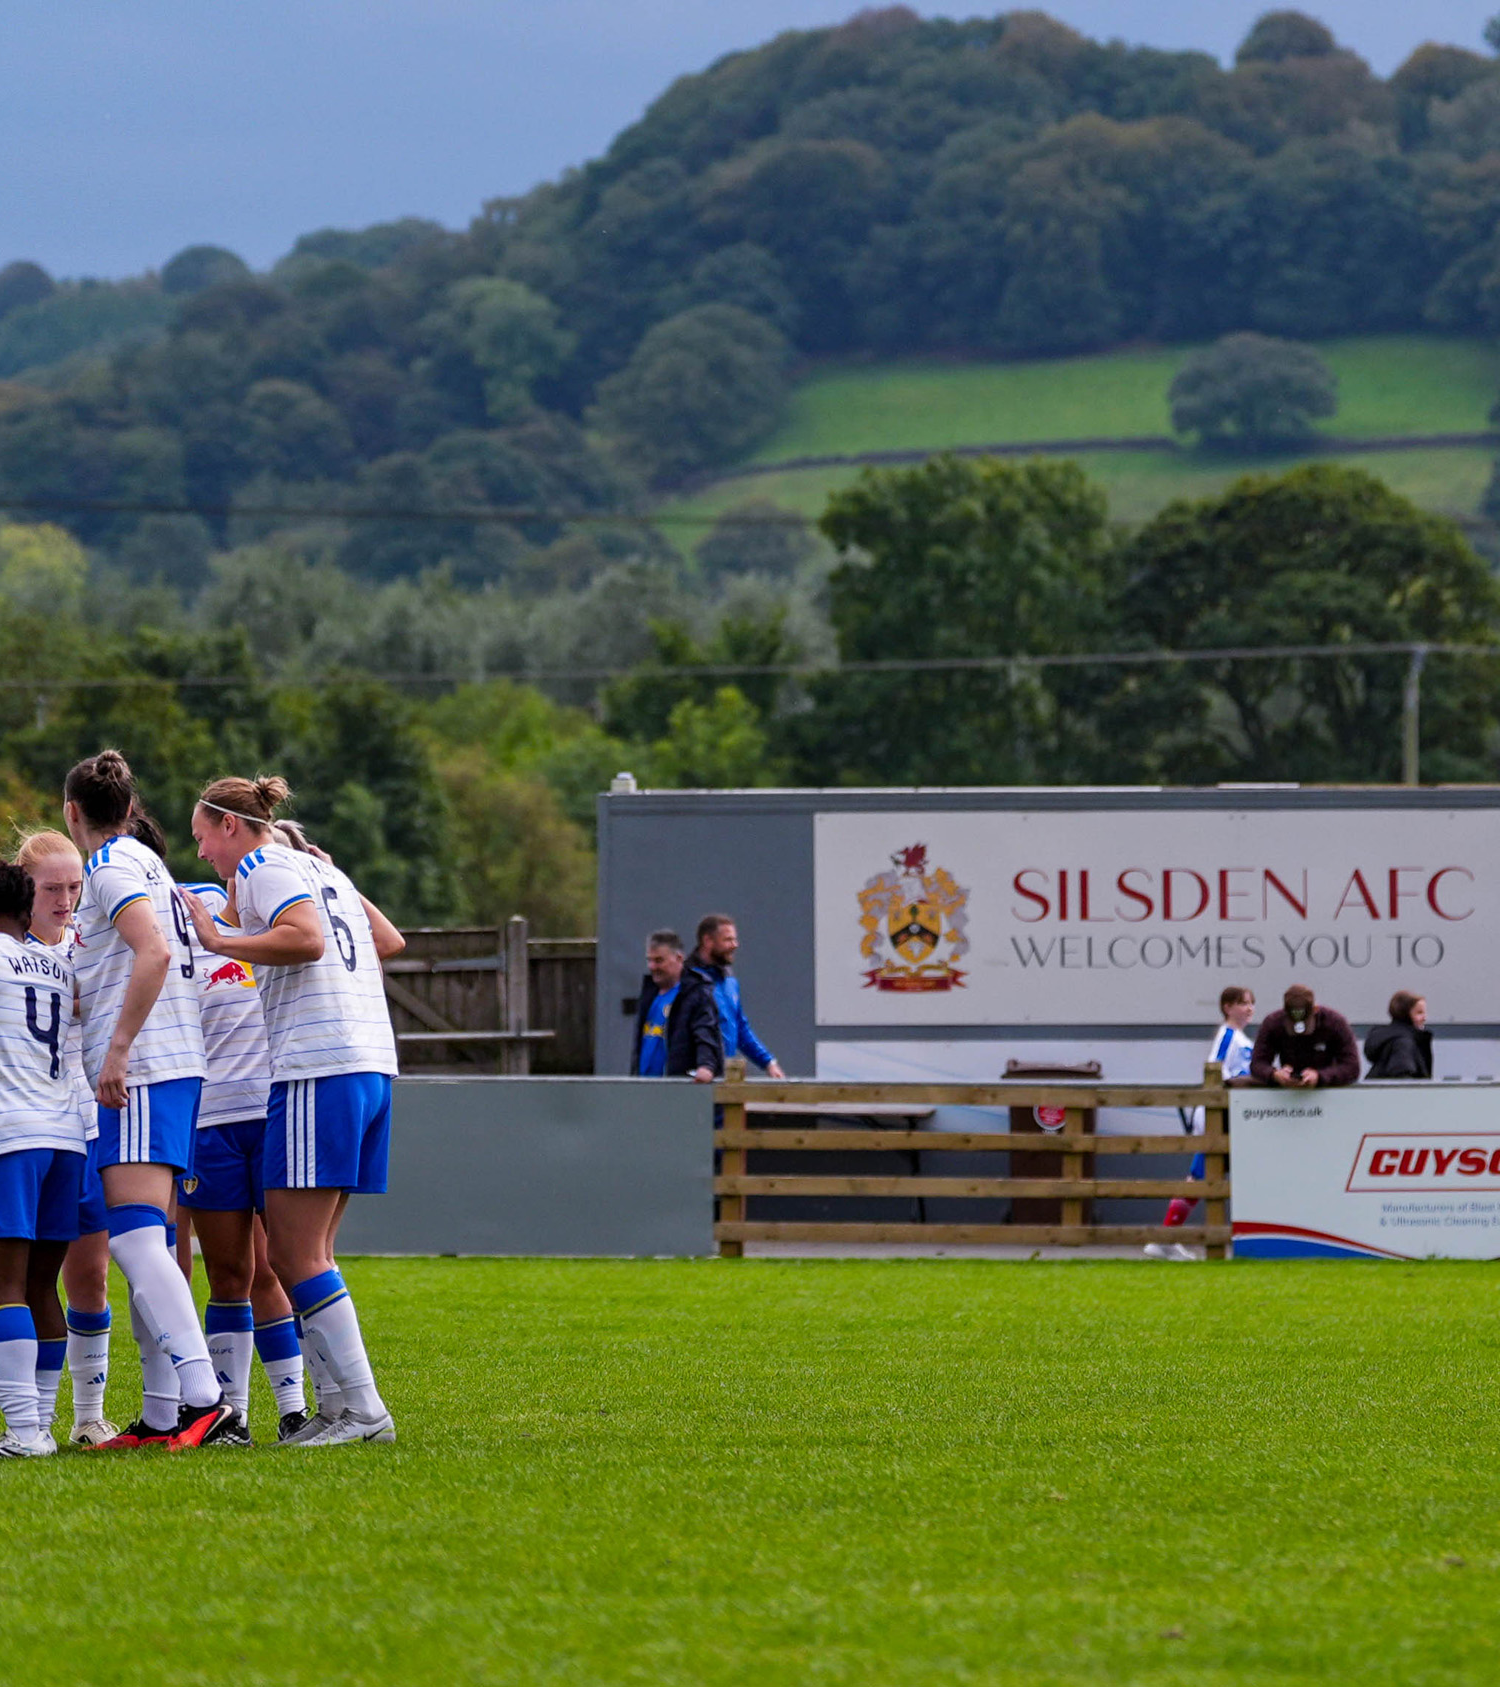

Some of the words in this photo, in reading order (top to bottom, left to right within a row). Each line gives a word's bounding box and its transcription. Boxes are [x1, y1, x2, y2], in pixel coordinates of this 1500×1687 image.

[1011, 866, 1308, 922] SILSDEN
[1333, 866, 1475, 922] AFC
[321, 886, 356, 972] 6
[8, 956, 69, 987] WATSON
[1011, 935, 1266, 968] WELCOMES
[1279, 935, 1372, 968] YOU
[1388, 935, 1445, 968] TO
[24, 986, 61, 1079] 4
[1243, 1106, 1323, 1120] guyson.co.uk
